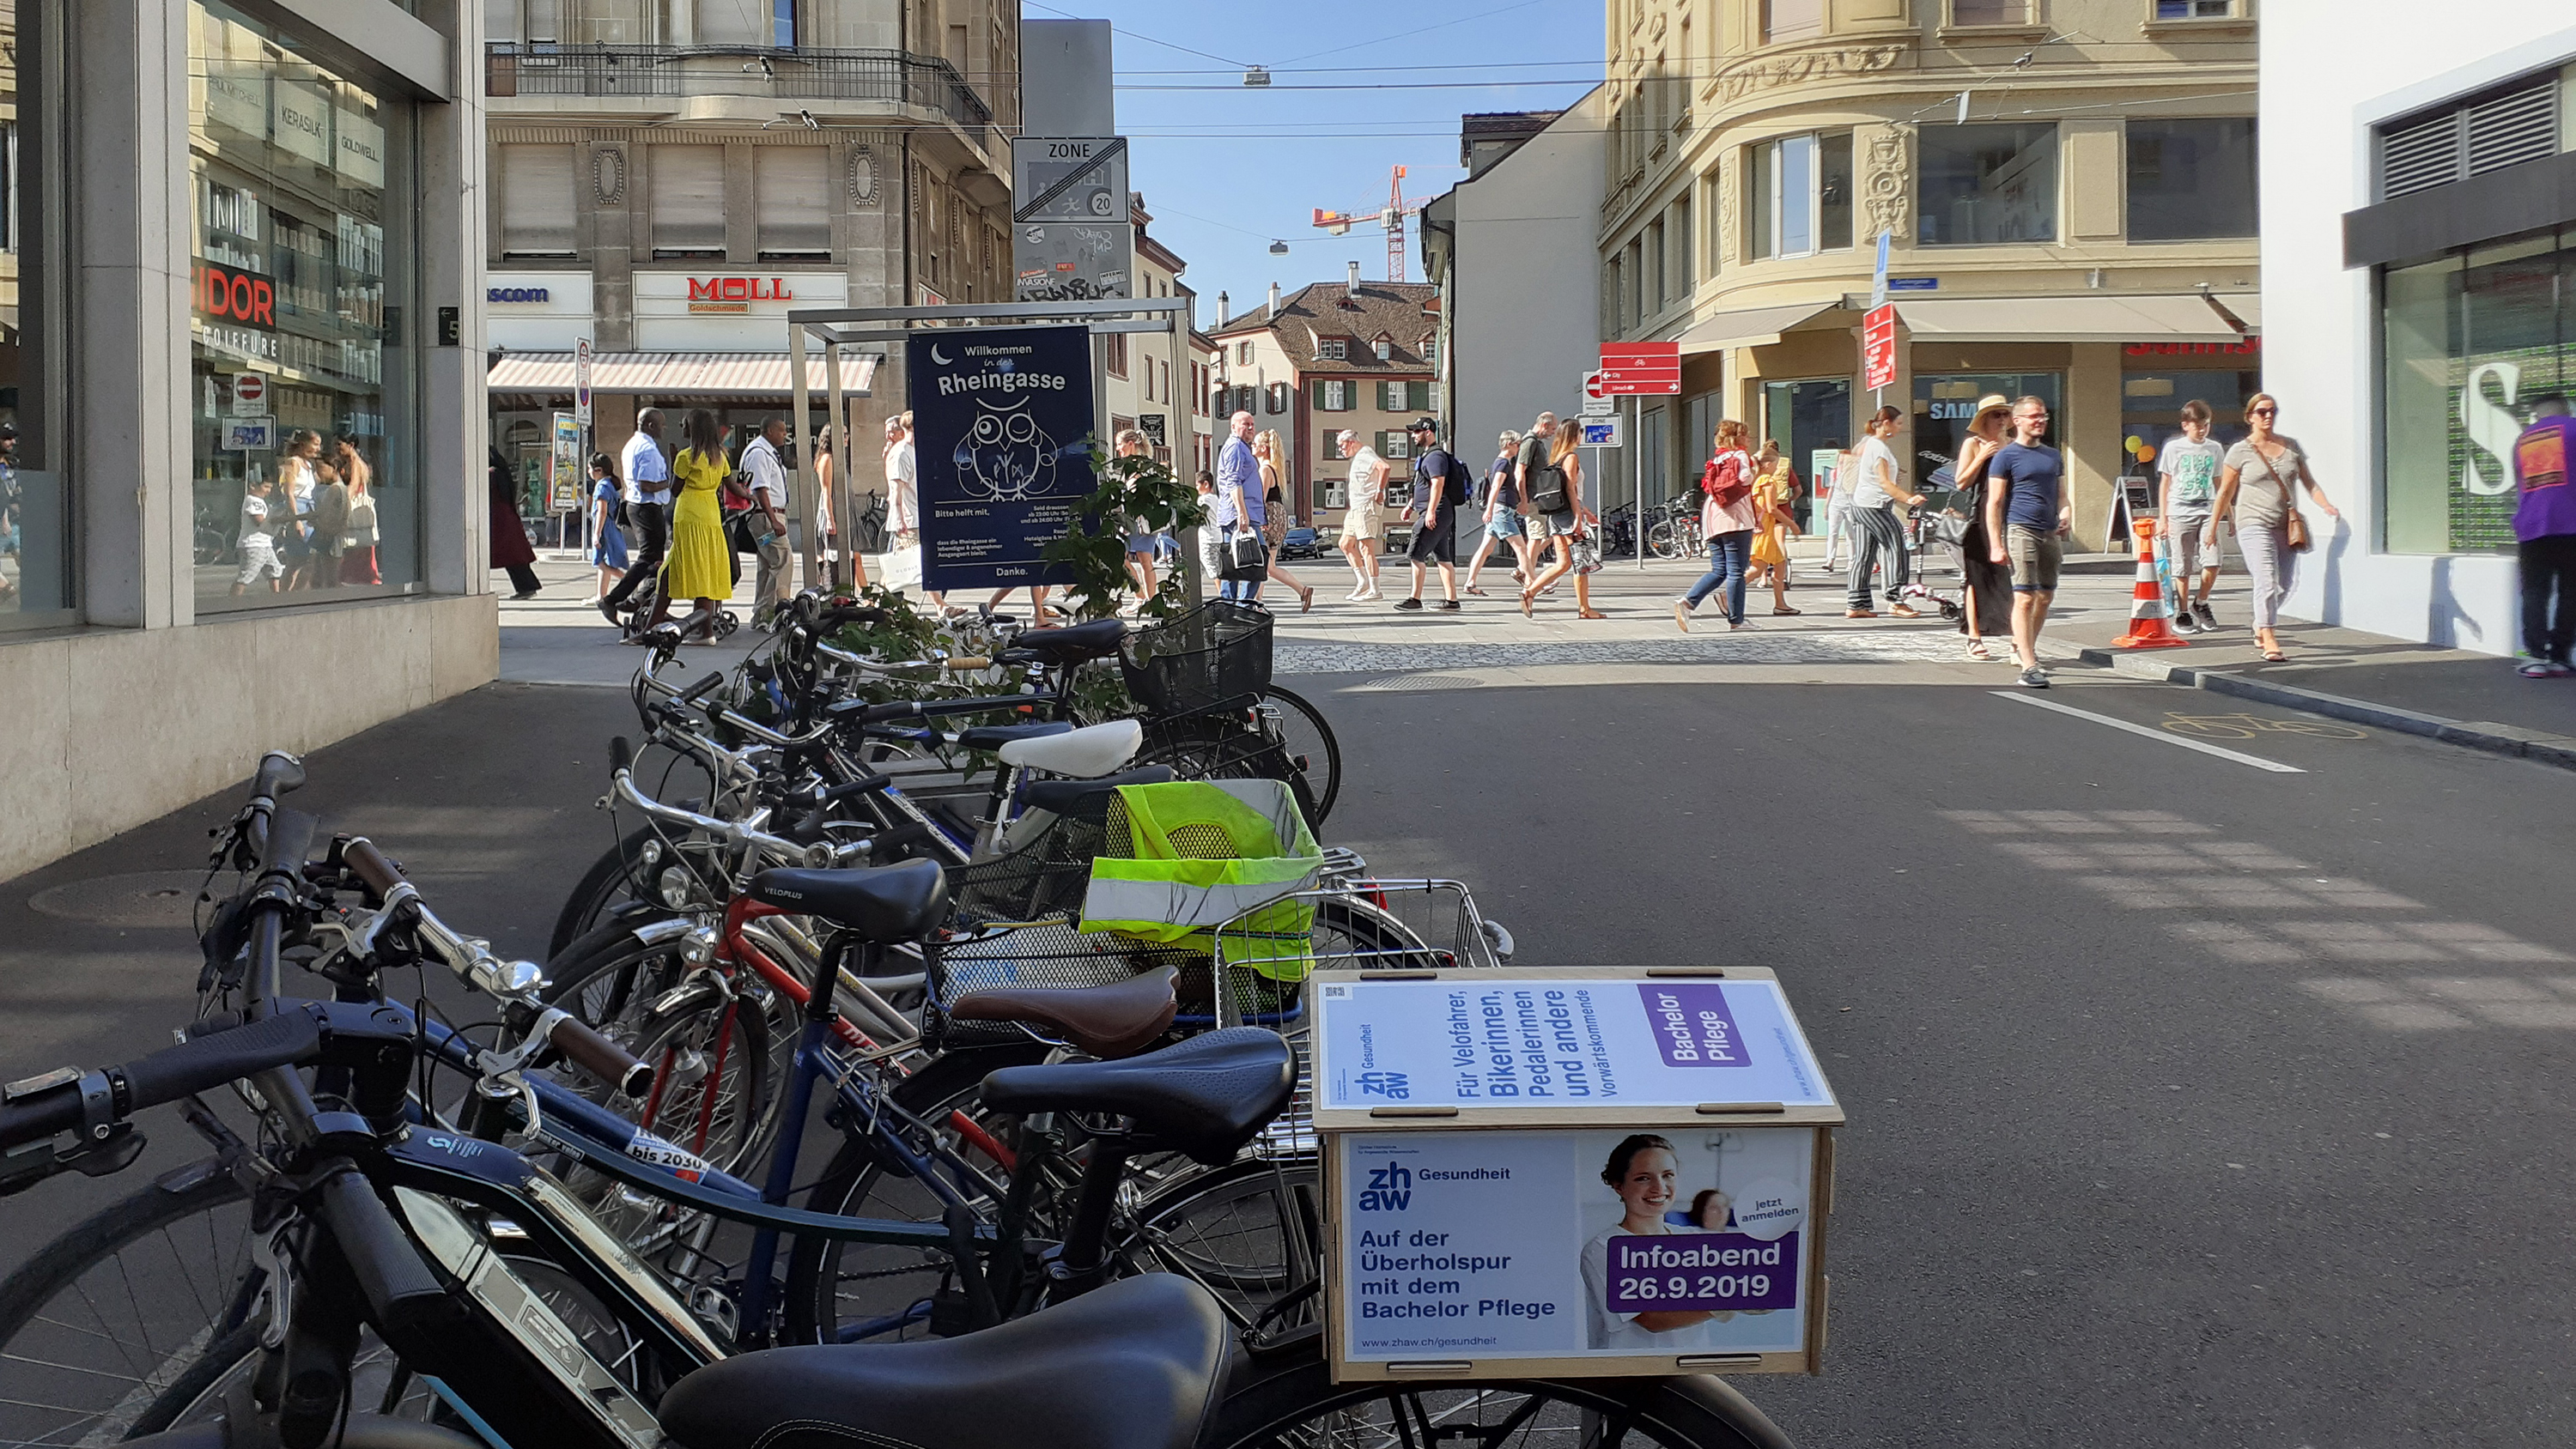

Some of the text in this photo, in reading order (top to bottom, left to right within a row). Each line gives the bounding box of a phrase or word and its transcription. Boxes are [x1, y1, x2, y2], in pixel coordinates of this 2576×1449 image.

[281, 105, 321, 138] KERASILK
[341, 136, 377, 161] GOLDWELL
[1048, 143, 1091, 158] ZONE
[1096, 197, 1110, 210] 20
[687, 277, 793, 300] MOLL
[689, 303, 745, 312] Goldschmiede
[203, 325, 277, 357] COIFFURE
[448, 320, 459, 339] 5
[964, 344, 1032, 358] Willkommen
[984, 357, 1015, 367] in der
[938, 369, 1066, 397] Rheingasse
[1930, 403, 1978, 420] SAM
[2459, 361, 2524, 495] S
[955, 508, 974, 517] helft
[996, 567, 1029, 577] Danke.
[763, 887, 803, 900] VELOPLUS
[1656, 992, 1700, 1061] Bachelor
[1698, 1009, 1735, 1061] Pflege
[1447, 991, 1481, 1097] Für Velofahrer,
[1479, 991, 1520, 1097] Bikerinnen,
[1513, 991, 1555, 1097] Pedalerinnen
[1543, 990, 1591, 1097] und andere
[1574, 989, 1619, 1097] Vorwärtskommende
[1354, 1023, 1385, 1094] zh Gesundheit
[1385, 1072, 1410, 1100] aw
[632, 1146, 658, 1161] bis
[1368, 1161, 1511, 1190] zh Gesundheit
[1358, 1190, 1412, 1211] aw
[1755, 1197, 1783, 1211] jetzt
[1741, 1207, 1800, 1223] anmelden
[1359, 1229, 1449, 1247] Auf der
[1360, 1250, 1512, 1274] Überholspur
[1620, 1241, 1781, 1270] Infoabend
[1361, 1277, 1461, 1295] mit dem
[1619, 1274, 1771, 1300] 26.9.2019
[1362, 1299, 1556, 1320] Bachelor Pflege
[1361, 1336, 1498, 1349] www.zhaw.ch/gesundheit
